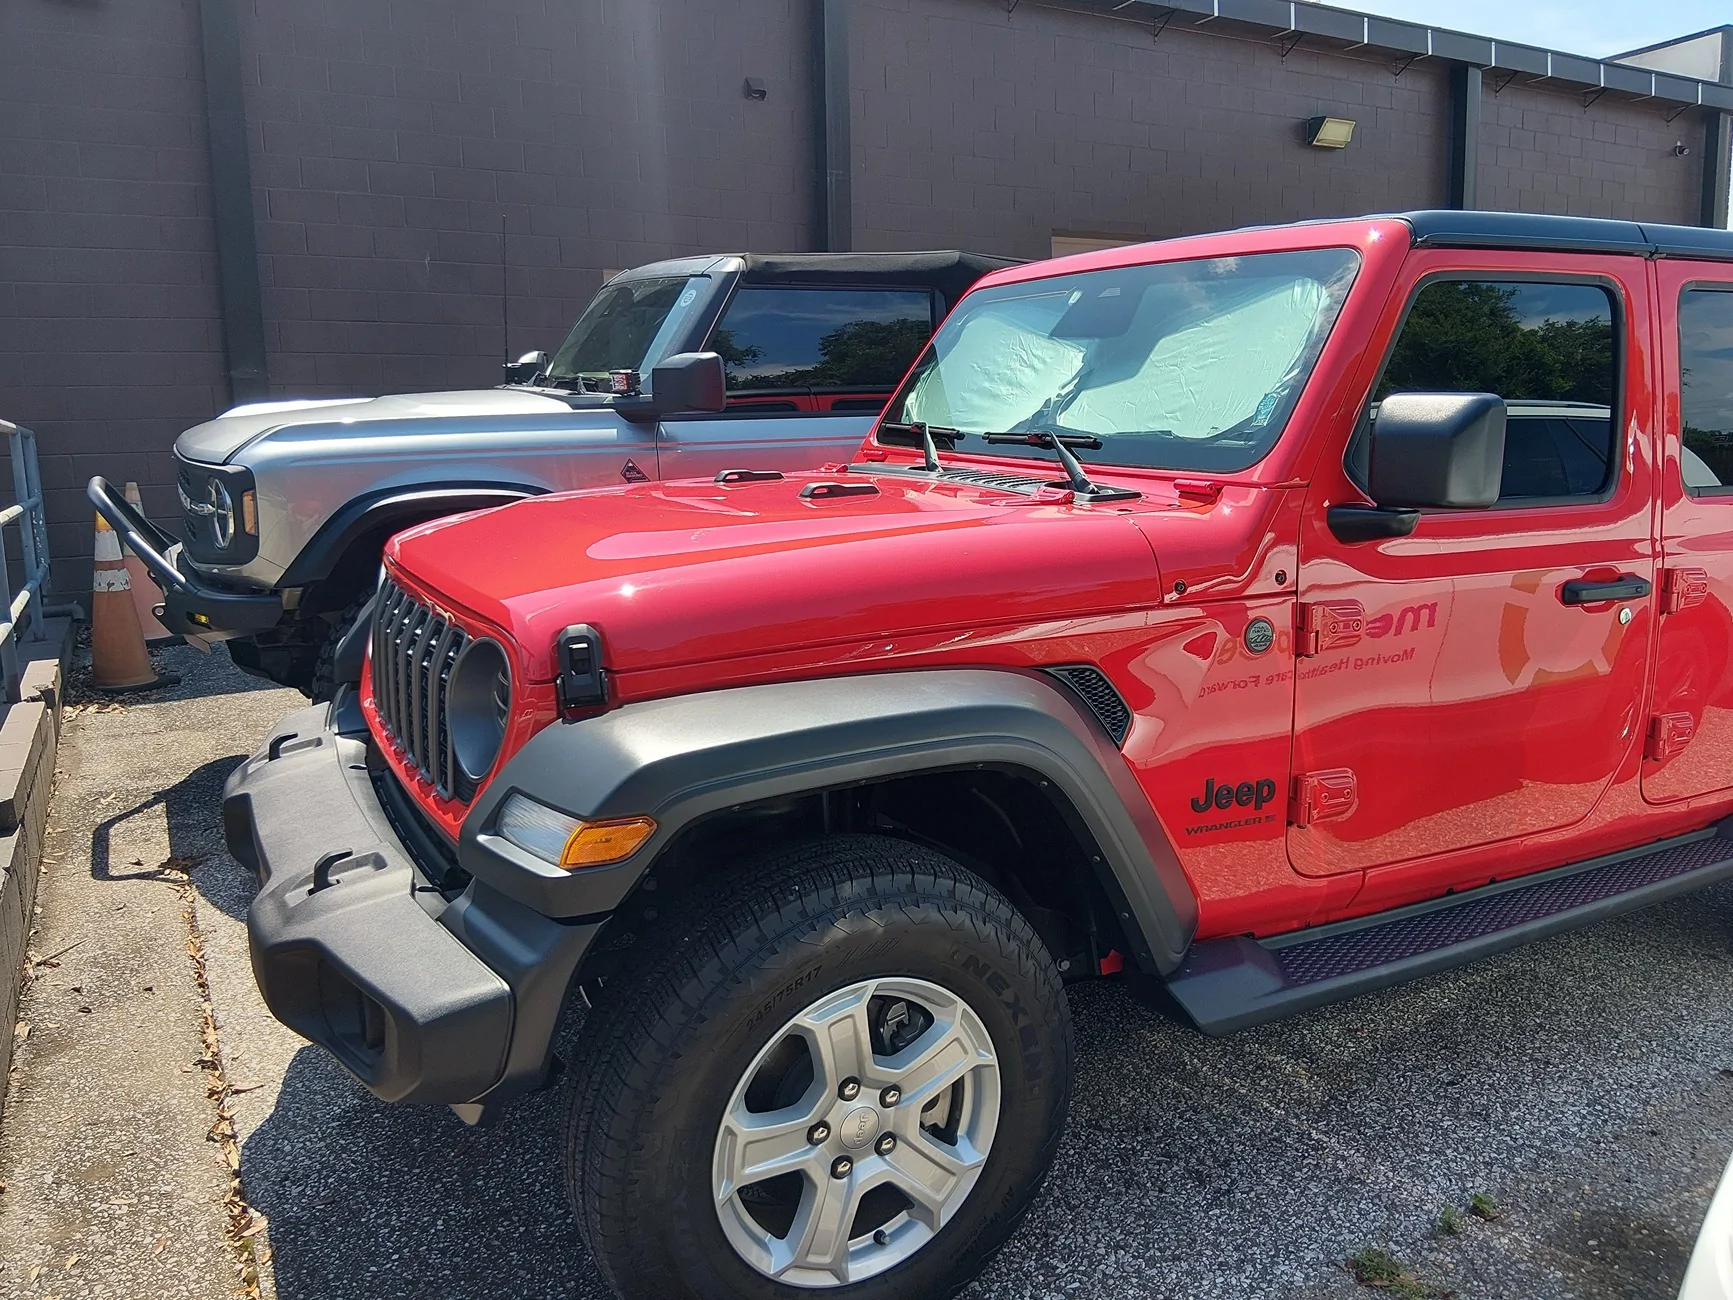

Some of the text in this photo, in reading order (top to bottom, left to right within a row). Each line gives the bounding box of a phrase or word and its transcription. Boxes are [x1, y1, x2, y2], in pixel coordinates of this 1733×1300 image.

[1190, 778, 1276, 814] Jeep
[1185, 816, 1262, 836] WRANGLER
[853, 1111, 870, 1145] Jeep
